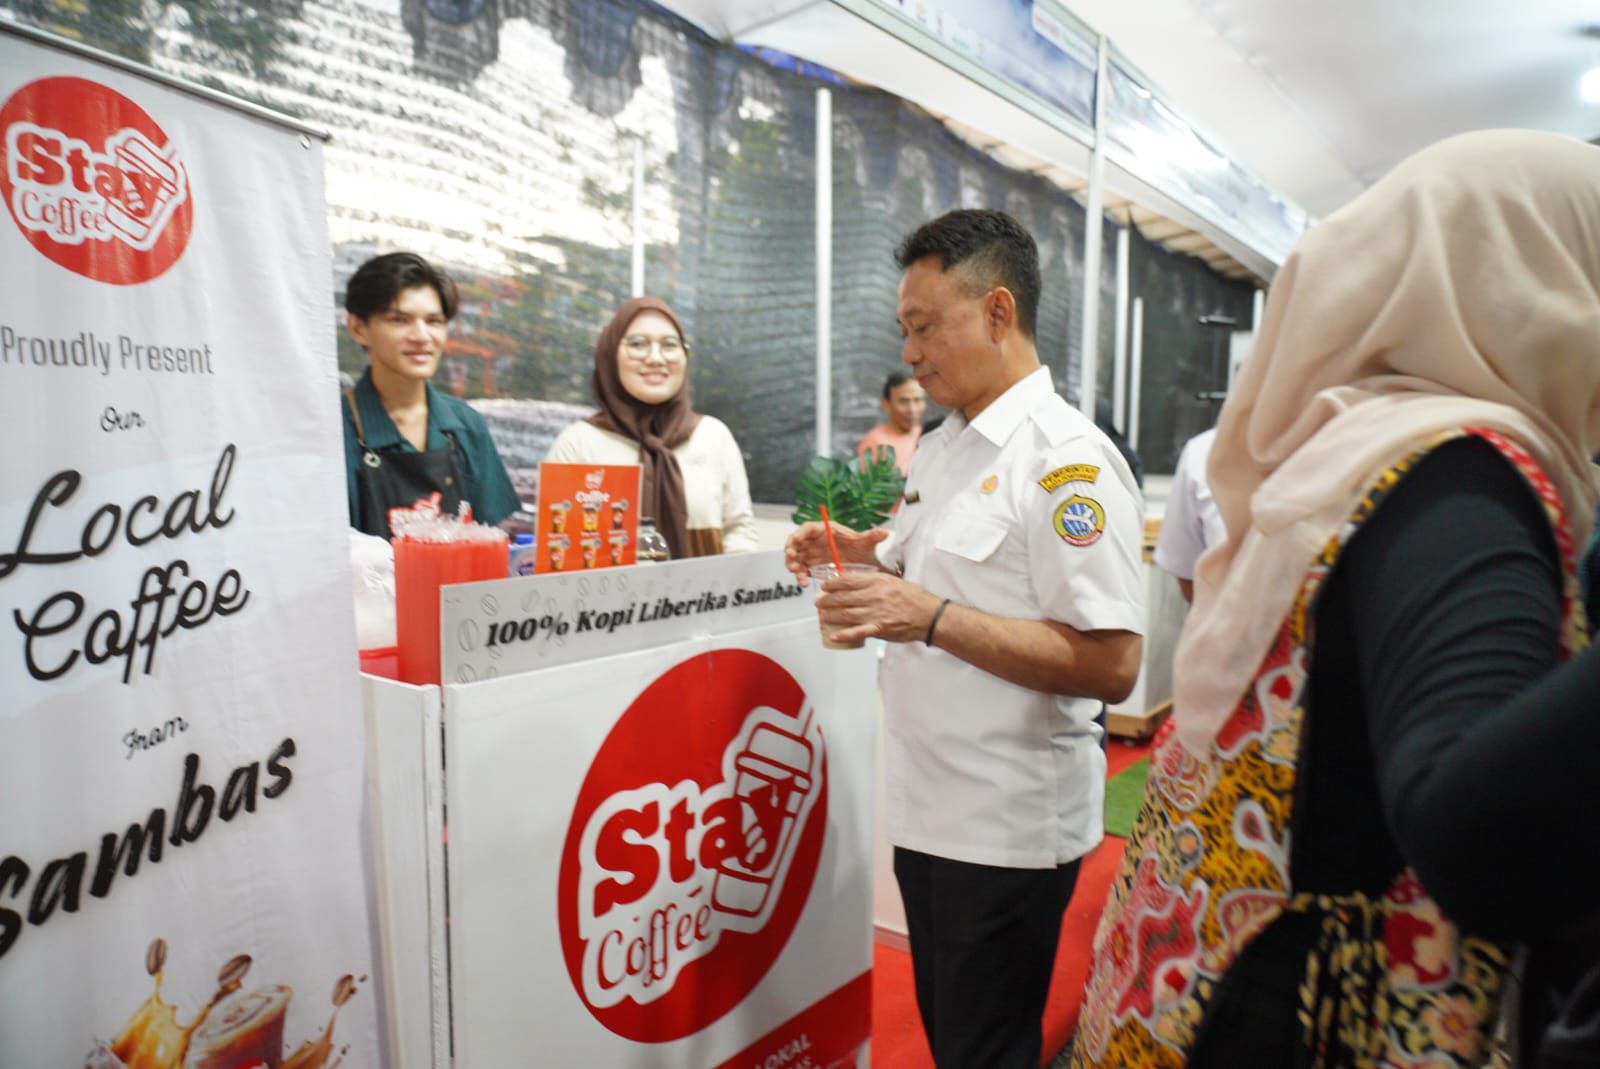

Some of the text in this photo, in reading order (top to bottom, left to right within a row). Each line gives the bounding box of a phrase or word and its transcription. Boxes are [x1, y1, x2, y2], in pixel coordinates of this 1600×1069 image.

[17, 131, 161, 218] Stay
[22, 190, 109, 236] Coffee
[0, 325, 214, 376] Proudly Present
[100, 406, 146, 432] Our
[0, 443, 236, 579] Local
[13, 559, 251, 684] Coffee
[485, 581, 803, 647] 100% Kopi Liberika Sambas
[593, 776, 798, 918] Stay
[597, 902, 712, 989] Coffee
